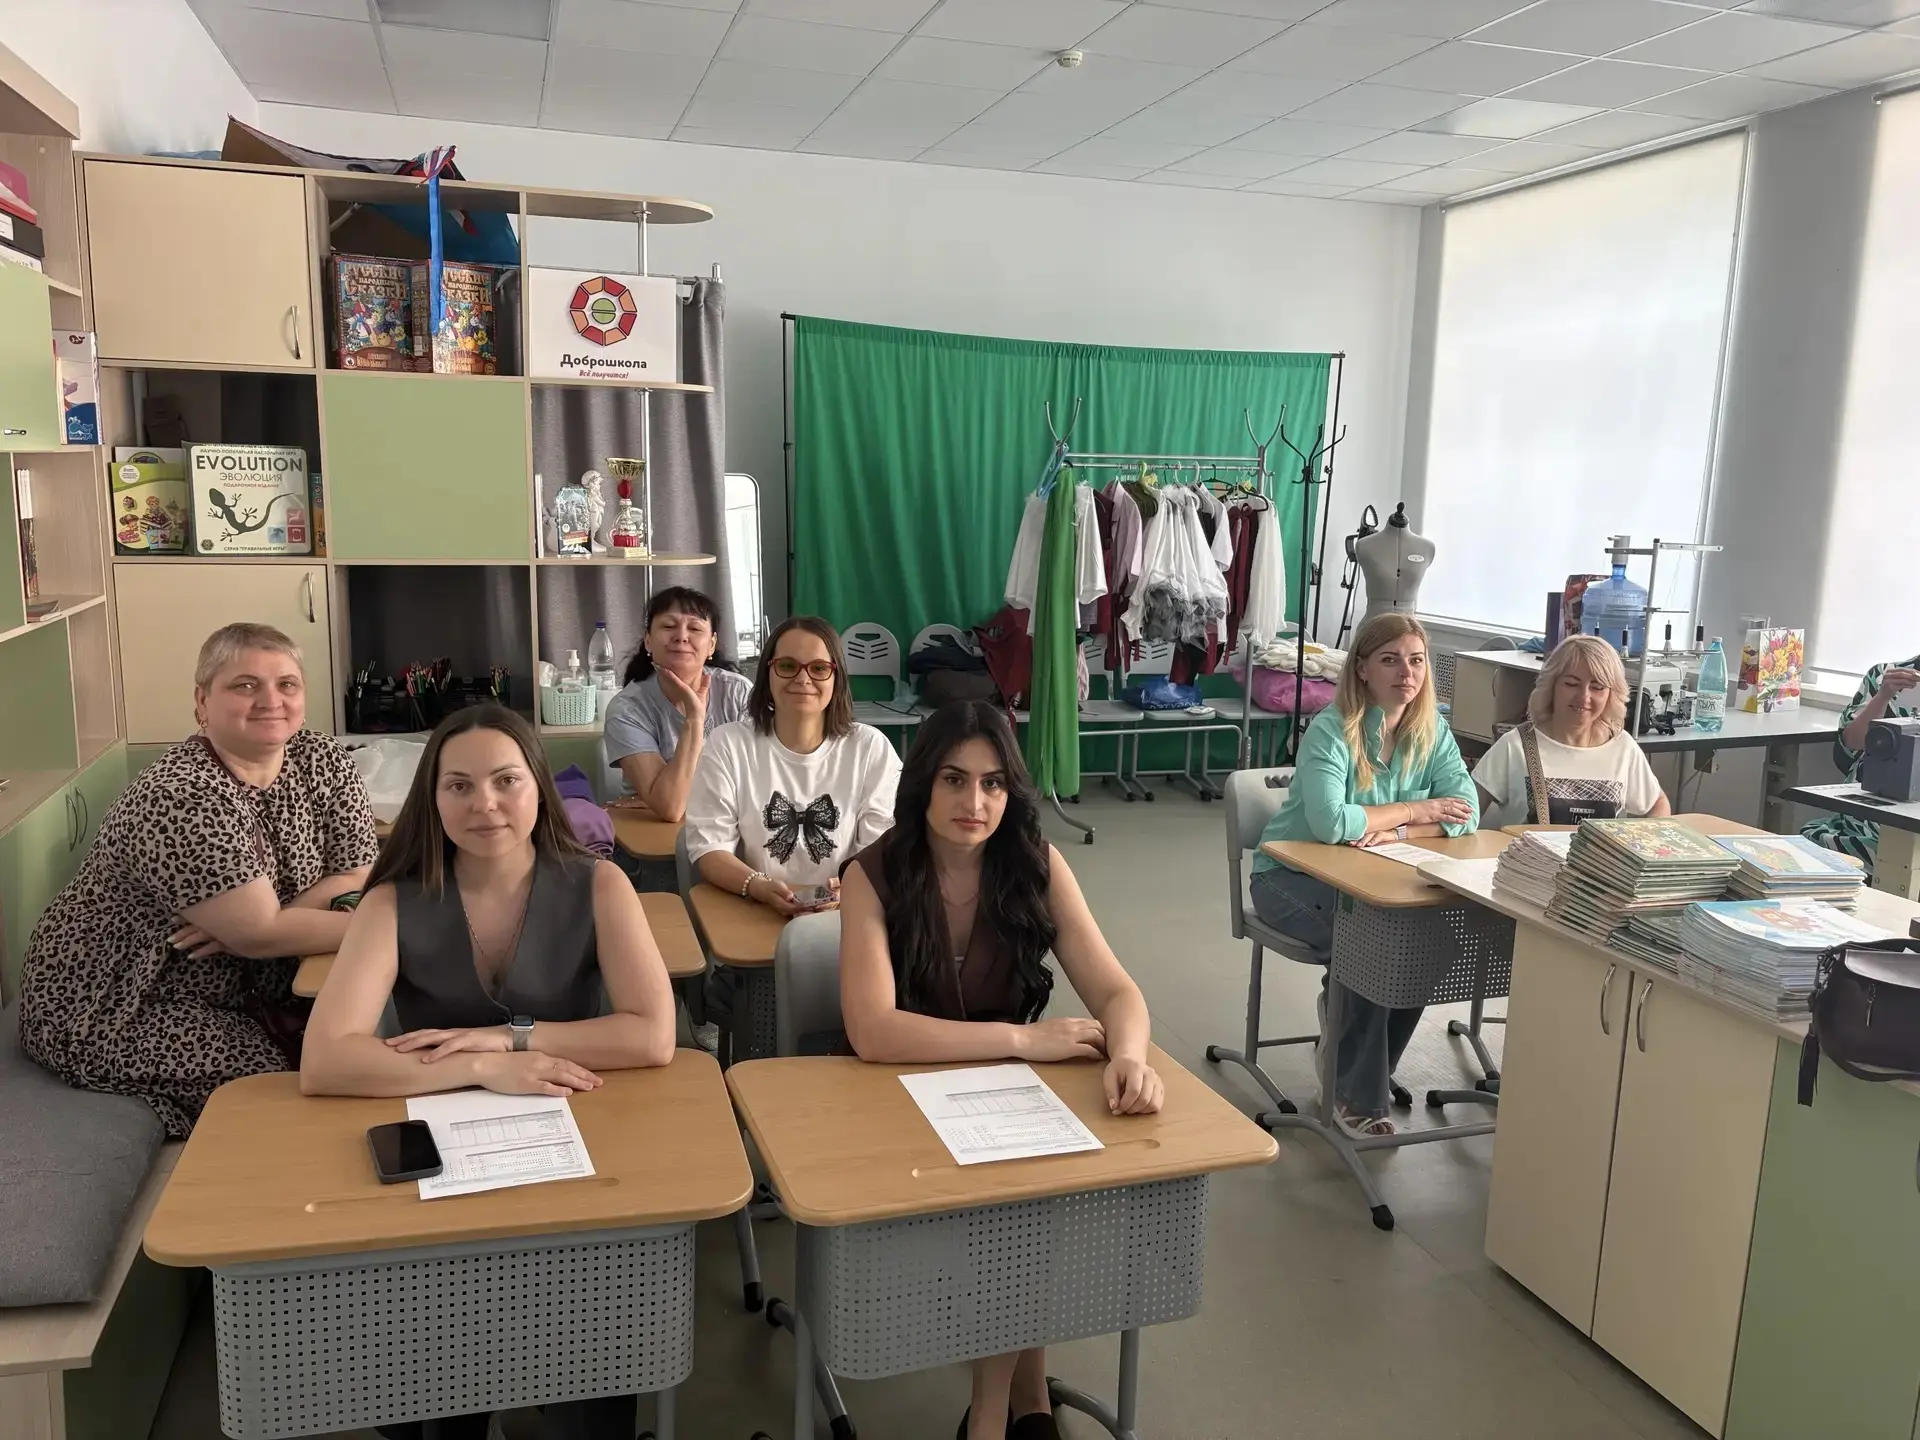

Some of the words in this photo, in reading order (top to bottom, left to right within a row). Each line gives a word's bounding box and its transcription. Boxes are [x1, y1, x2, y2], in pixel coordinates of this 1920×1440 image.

[443, 269, 489, 286] УССКИЕ
[560, 353, 647, 369] Доброшкола
[579, 369, 591, 377] Всё
[591, 371, 629, 379] получится!
[196, 455, 303, 472] EVOLUTION
[219, 472, 283, 482] ЭВОЛЮЦИЯ
